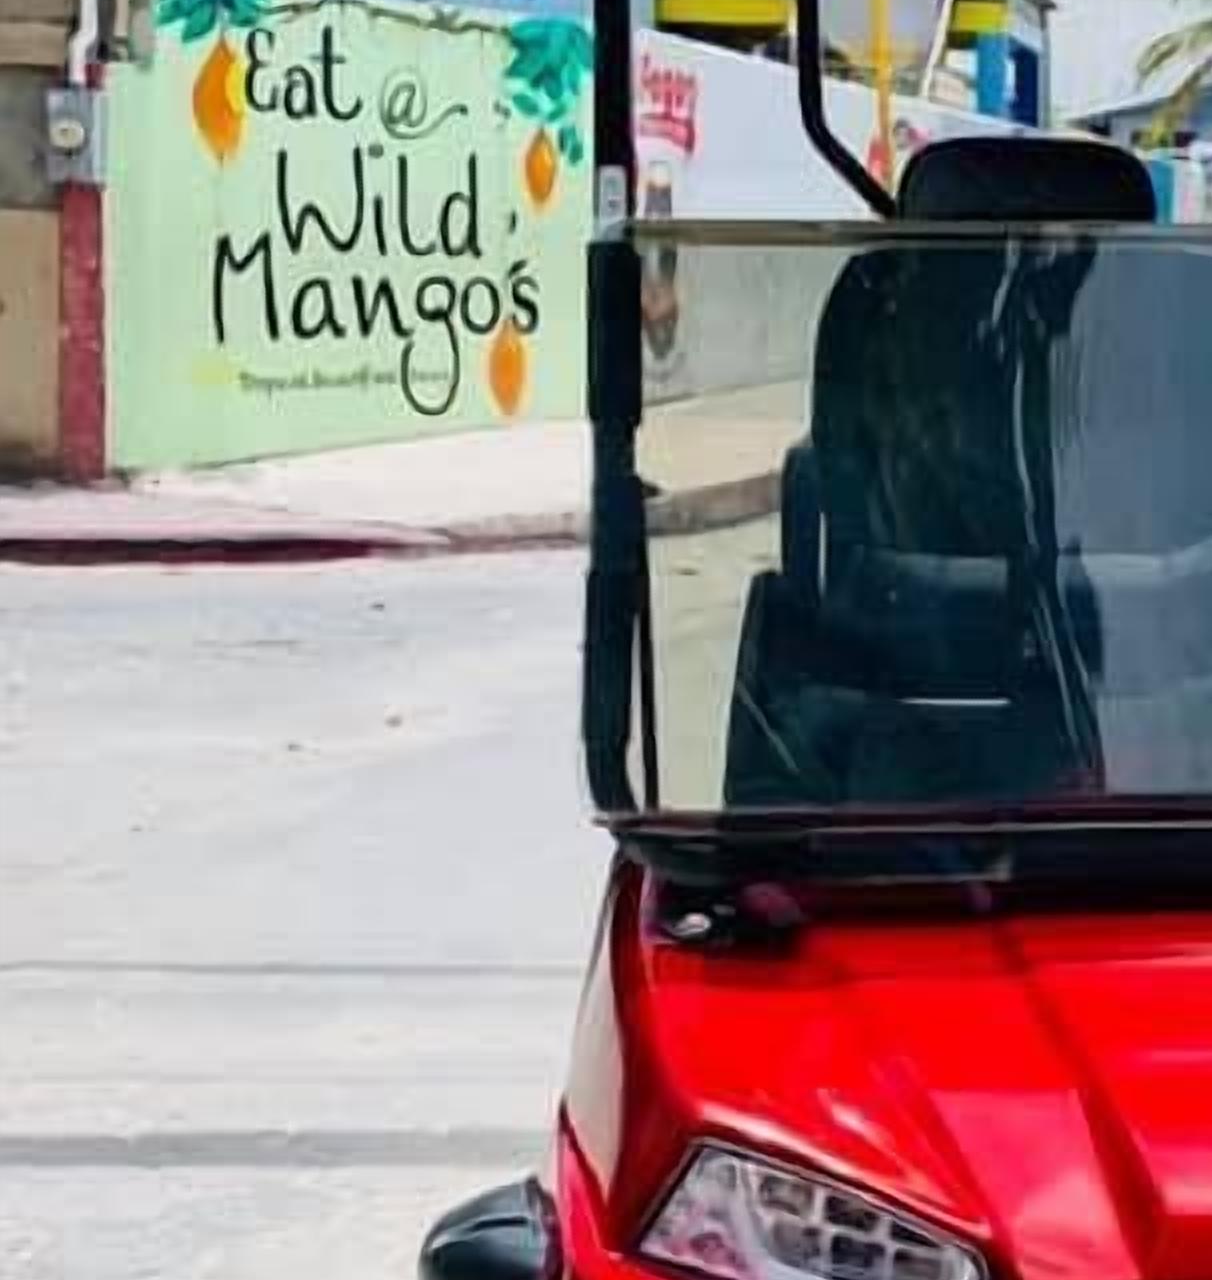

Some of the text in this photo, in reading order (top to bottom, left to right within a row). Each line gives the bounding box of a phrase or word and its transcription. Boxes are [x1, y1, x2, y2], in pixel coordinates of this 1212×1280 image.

[244, 25, 469, 140] Eat @
[276, 144, 482, 258] Wild
